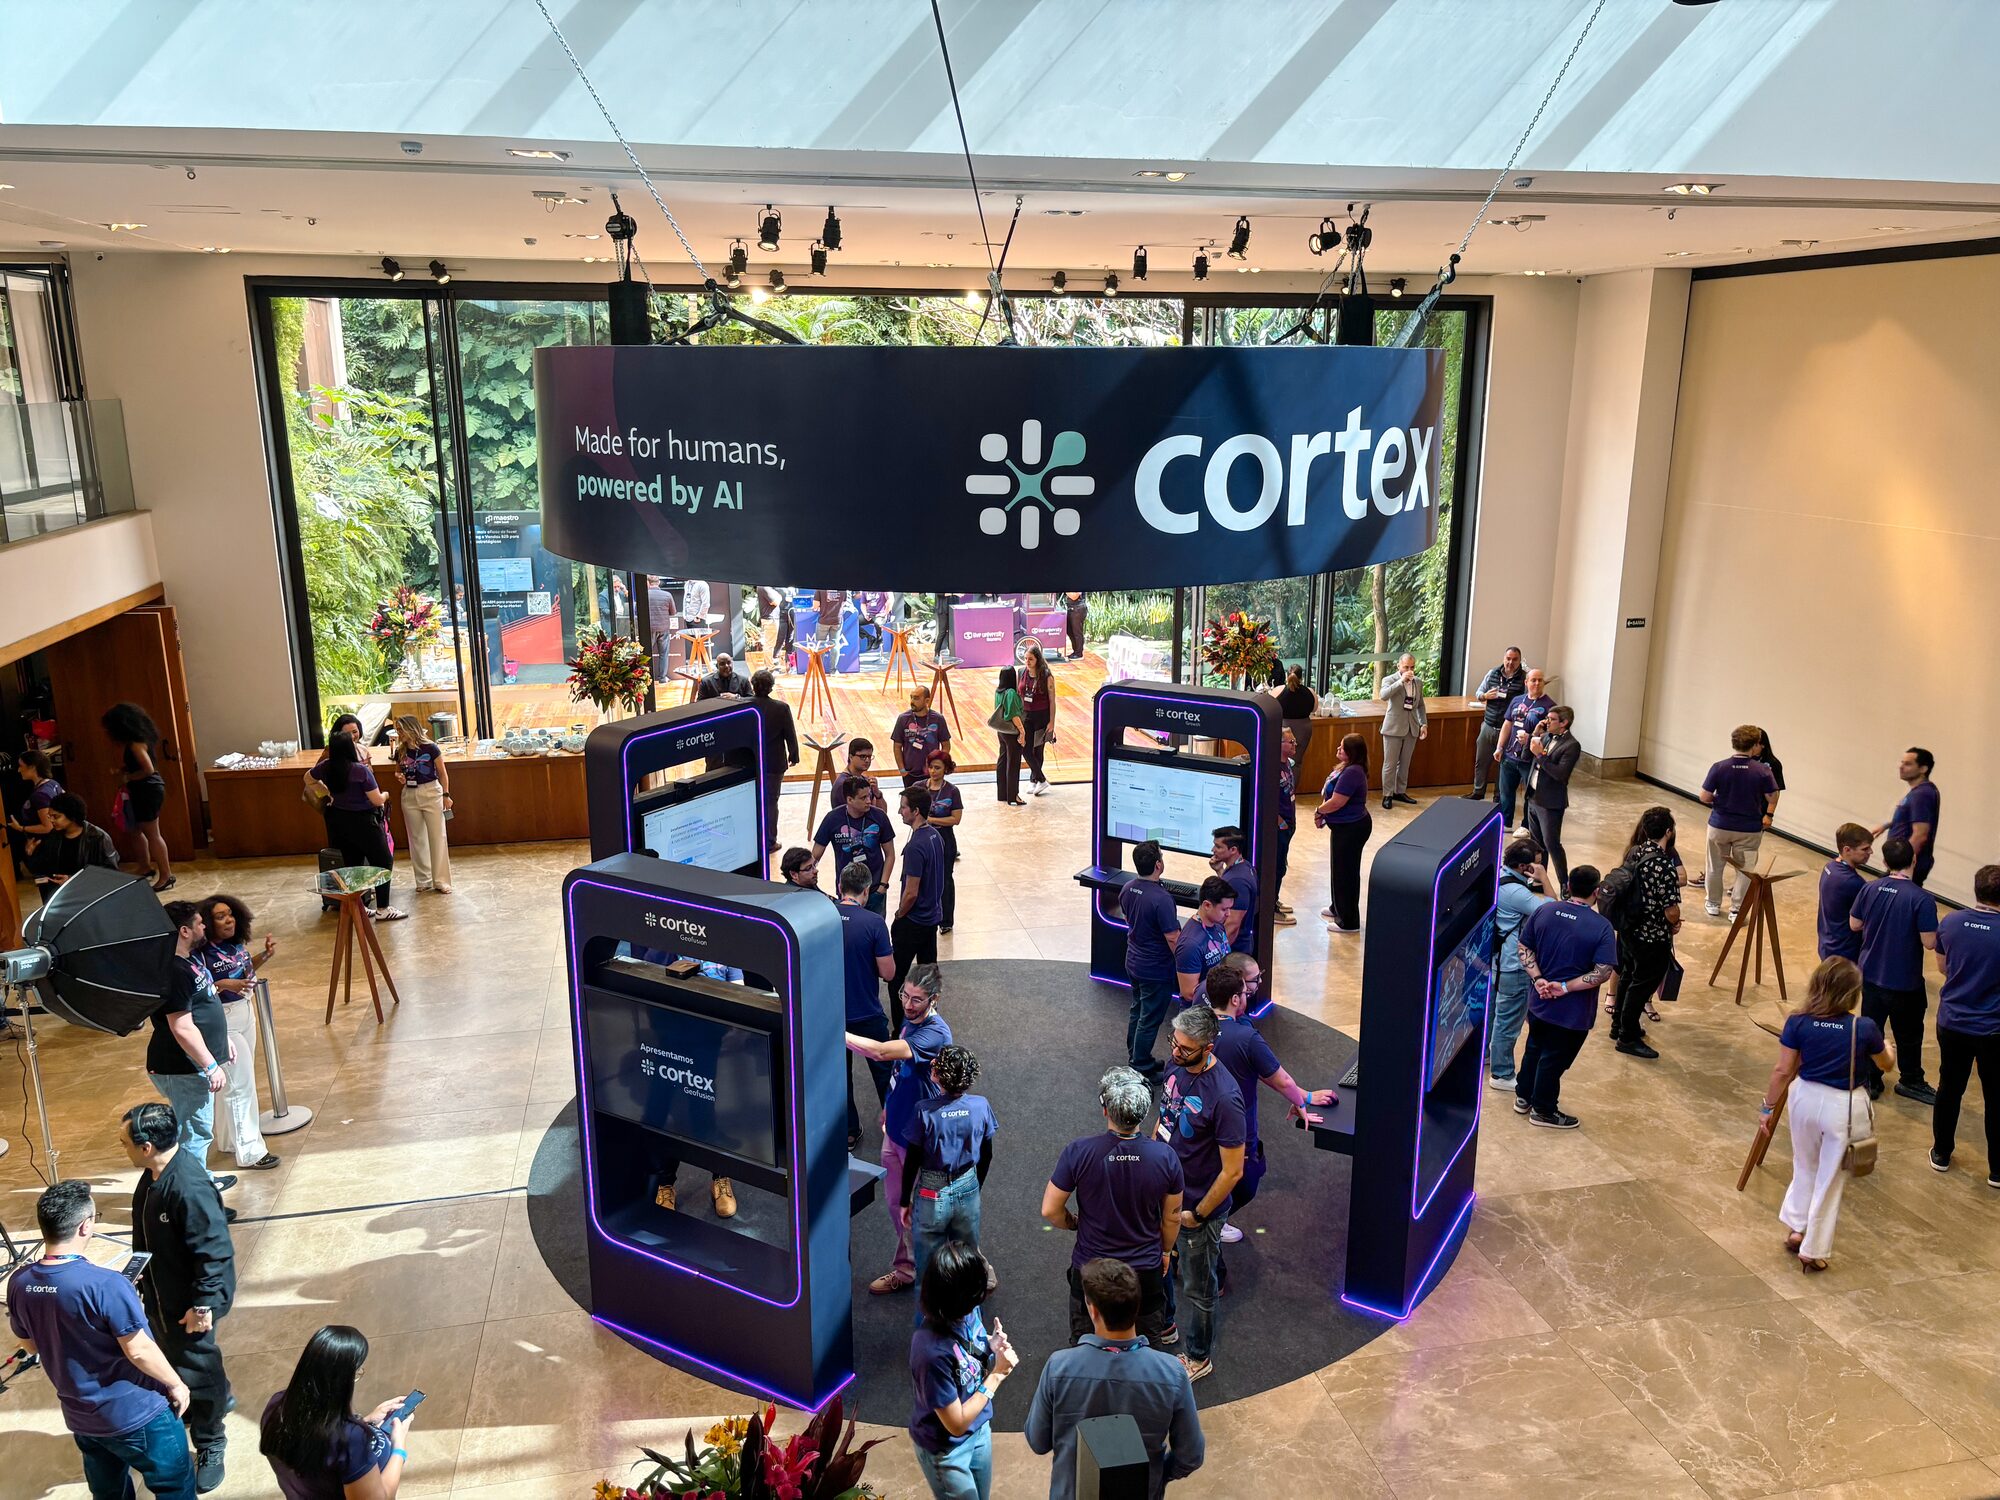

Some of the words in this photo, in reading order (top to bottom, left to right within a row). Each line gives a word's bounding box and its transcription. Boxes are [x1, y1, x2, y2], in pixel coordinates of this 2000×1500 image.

[575, 425, 623, 455] Made
[628, 427, 661, 458] for
[668, 429, 786, 471] humans,
[1134, 405, 1434, 535] cortex
[577, 474, 663, 504] powered
[670, 475, 704, 514] by
[712, 480, 744, 510] AI
[1166, 710, 1200, 722] cortex
[685, 731, 715, 747] cortex
[1464, 848, 1480, 871] cortex
[1560, 912, 1577, 920] cortex
[659, 916, 707, 938] cortex
[1970, 922, 1991, 930] cortex
[679, 934, 708, 946] Geofusion
[1820, 1021, 1844, 1030] cortex
[640, 1042, 694, 1065] Apresentamos
[658, 1064, 715, 1093] cortex
[683, 1086, 716, 1102] Geofusion
[947, 1109, 969, 1117] cortex
[32, 1285, 58, 1293] cortex
